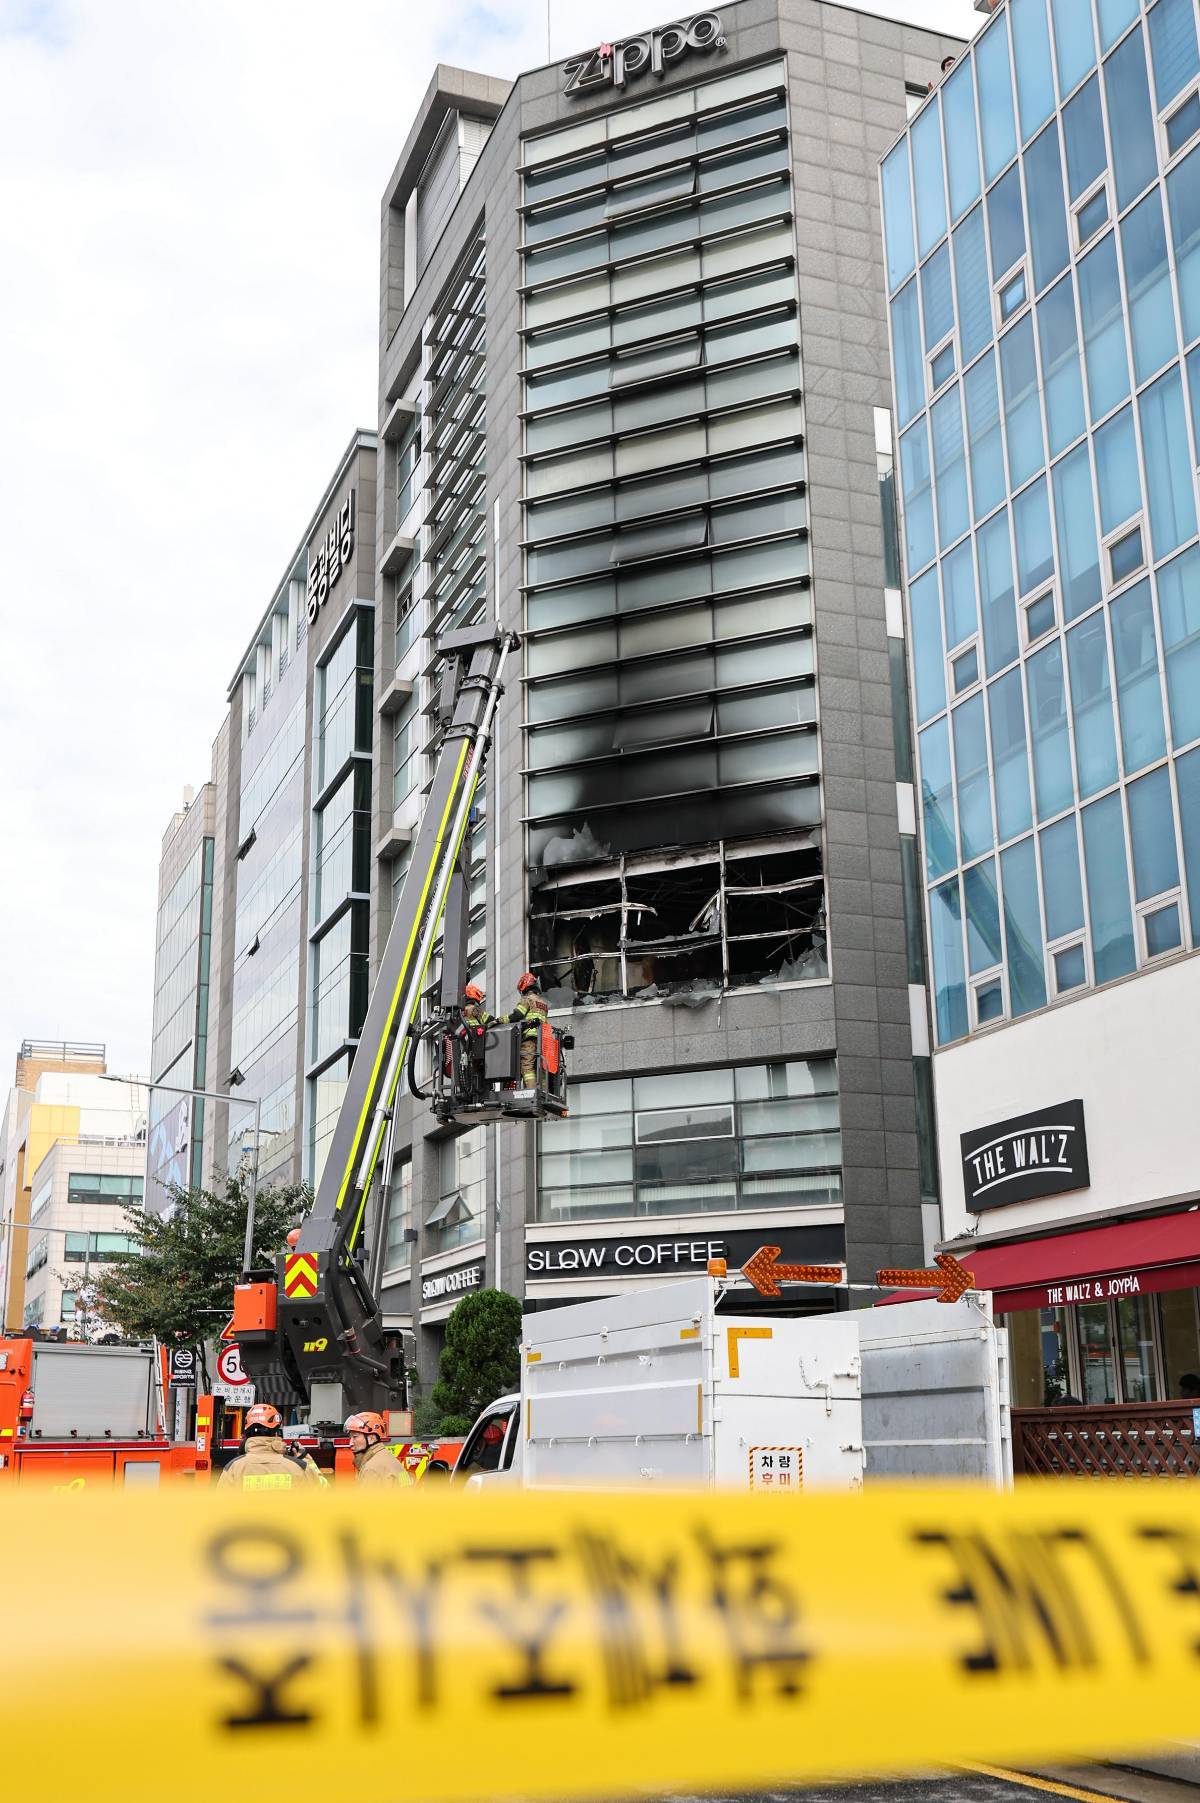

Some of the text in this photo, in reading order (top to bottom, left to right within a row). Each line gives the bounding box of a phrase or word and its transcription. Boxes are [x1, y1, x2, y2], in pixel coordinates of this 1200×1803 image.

[972, 1133, 1068, 1184] THE WAL'Z
[614, 1240, 725, 1266] COFFEE
[446, 1265, 480, 1293] COFFEE
[1047, 1287, 1063, 1304] THE
[1065, 1283, 1091, 1302] WAL'Z
[1094, 1282, 1104, 1297] &
[304, 1337, 328, 1353] 119
[761, 1455, 791, 1468] 차량
[761, 1472, 791, 1487] 후미
